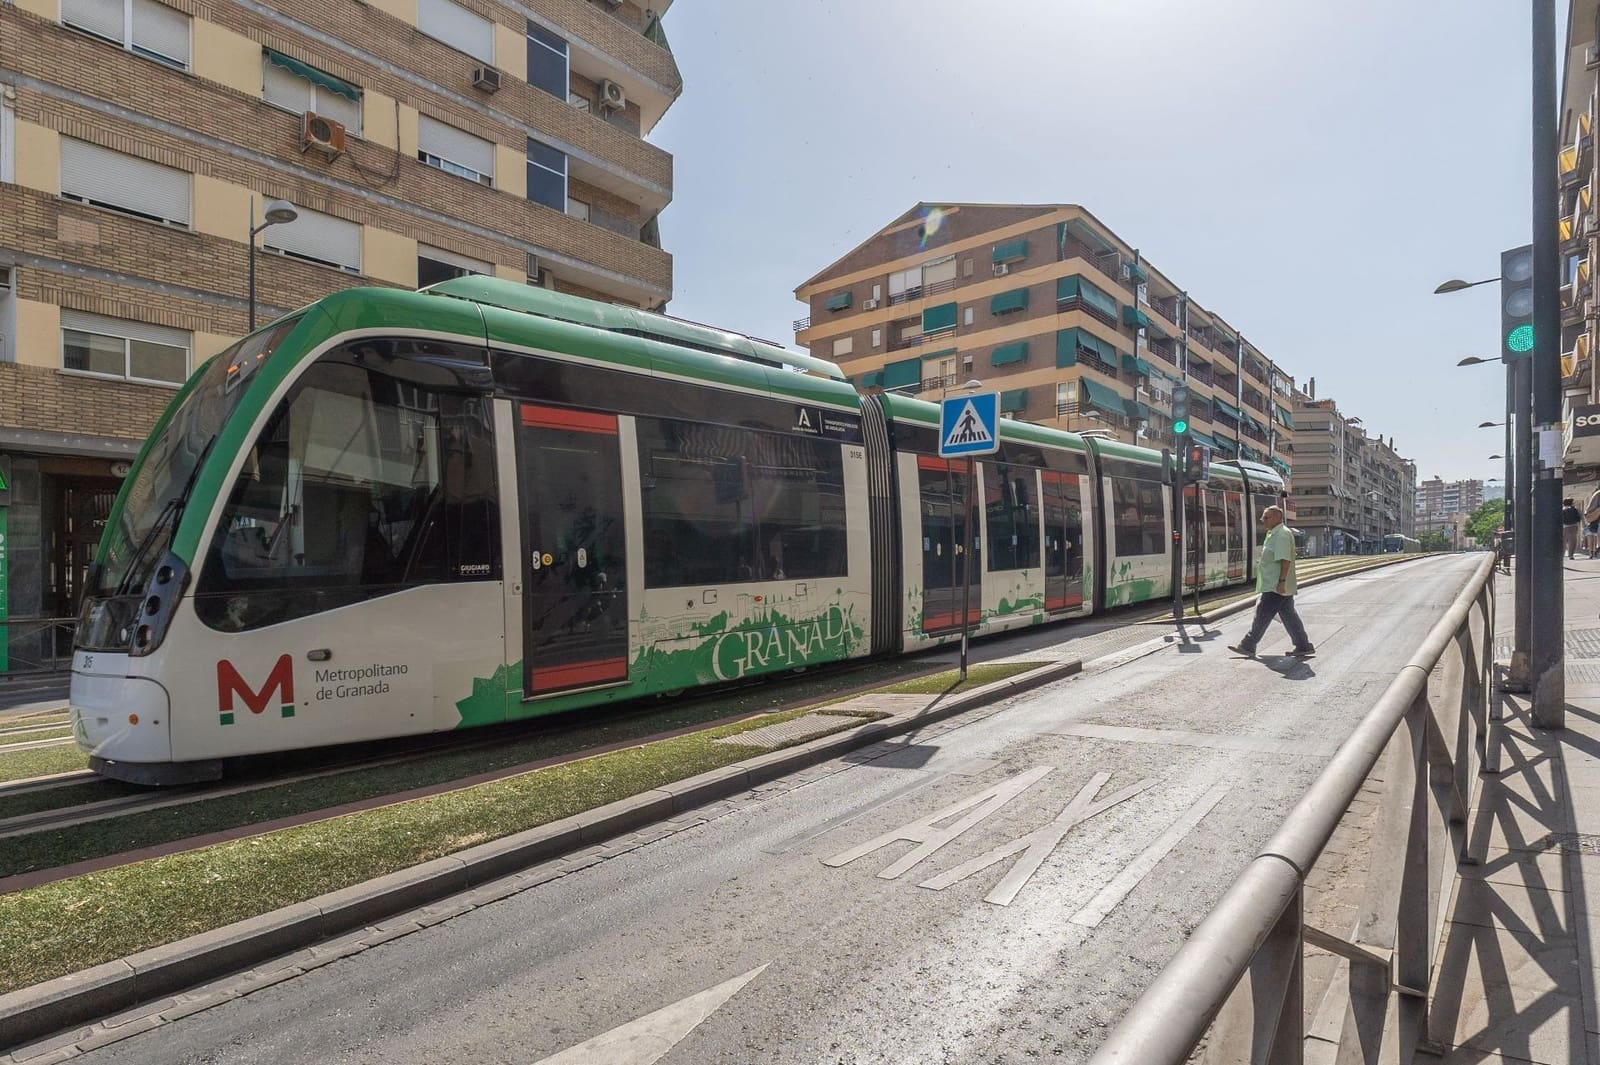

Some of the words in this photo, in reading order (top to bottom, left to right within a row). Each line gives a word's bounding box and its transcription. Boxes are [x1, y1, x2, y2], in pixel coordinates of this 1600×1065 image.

[712, 604, 856, 681] GRANADA
[217, 653, 295, 726] M
[315, 663, 409, 683] Metropolitano
[316, 688, 332, 701] de
[336, 681, 390, 700] Granada
